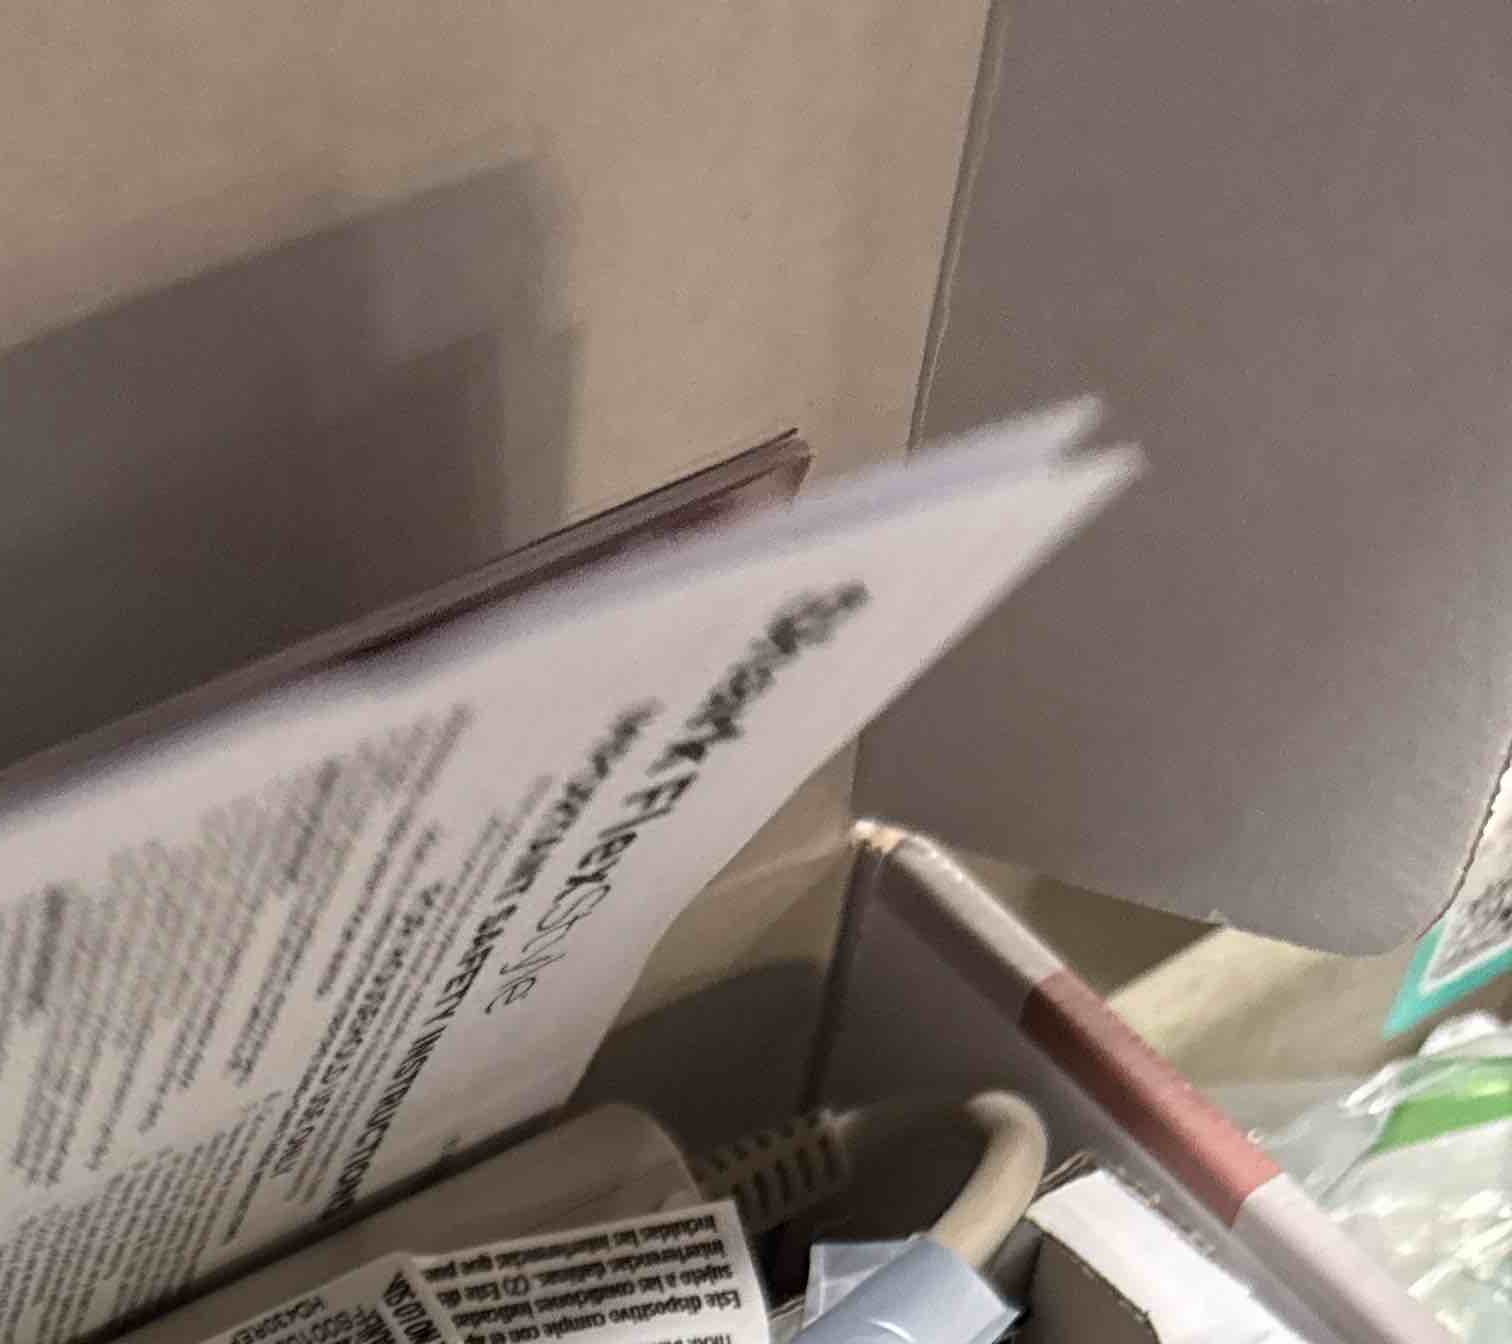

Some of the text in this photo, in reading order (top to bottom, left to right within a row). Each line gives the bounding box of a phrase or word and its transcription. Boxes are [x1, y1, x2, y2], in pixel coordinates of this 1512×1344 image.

[636, 1275, 663, 1294] las
[664, 1272, 677, 1287] a
[677, 1262, 733, 1289] sujeto
[533, 1281, 636, 1315] condiciones
[605, 1293, 703, 1328] dispositivo
[704, 1289, 741, 1313] Este
[507, 1322, 540, 1344] con
[541, 1310, 606, 1340] cumple
